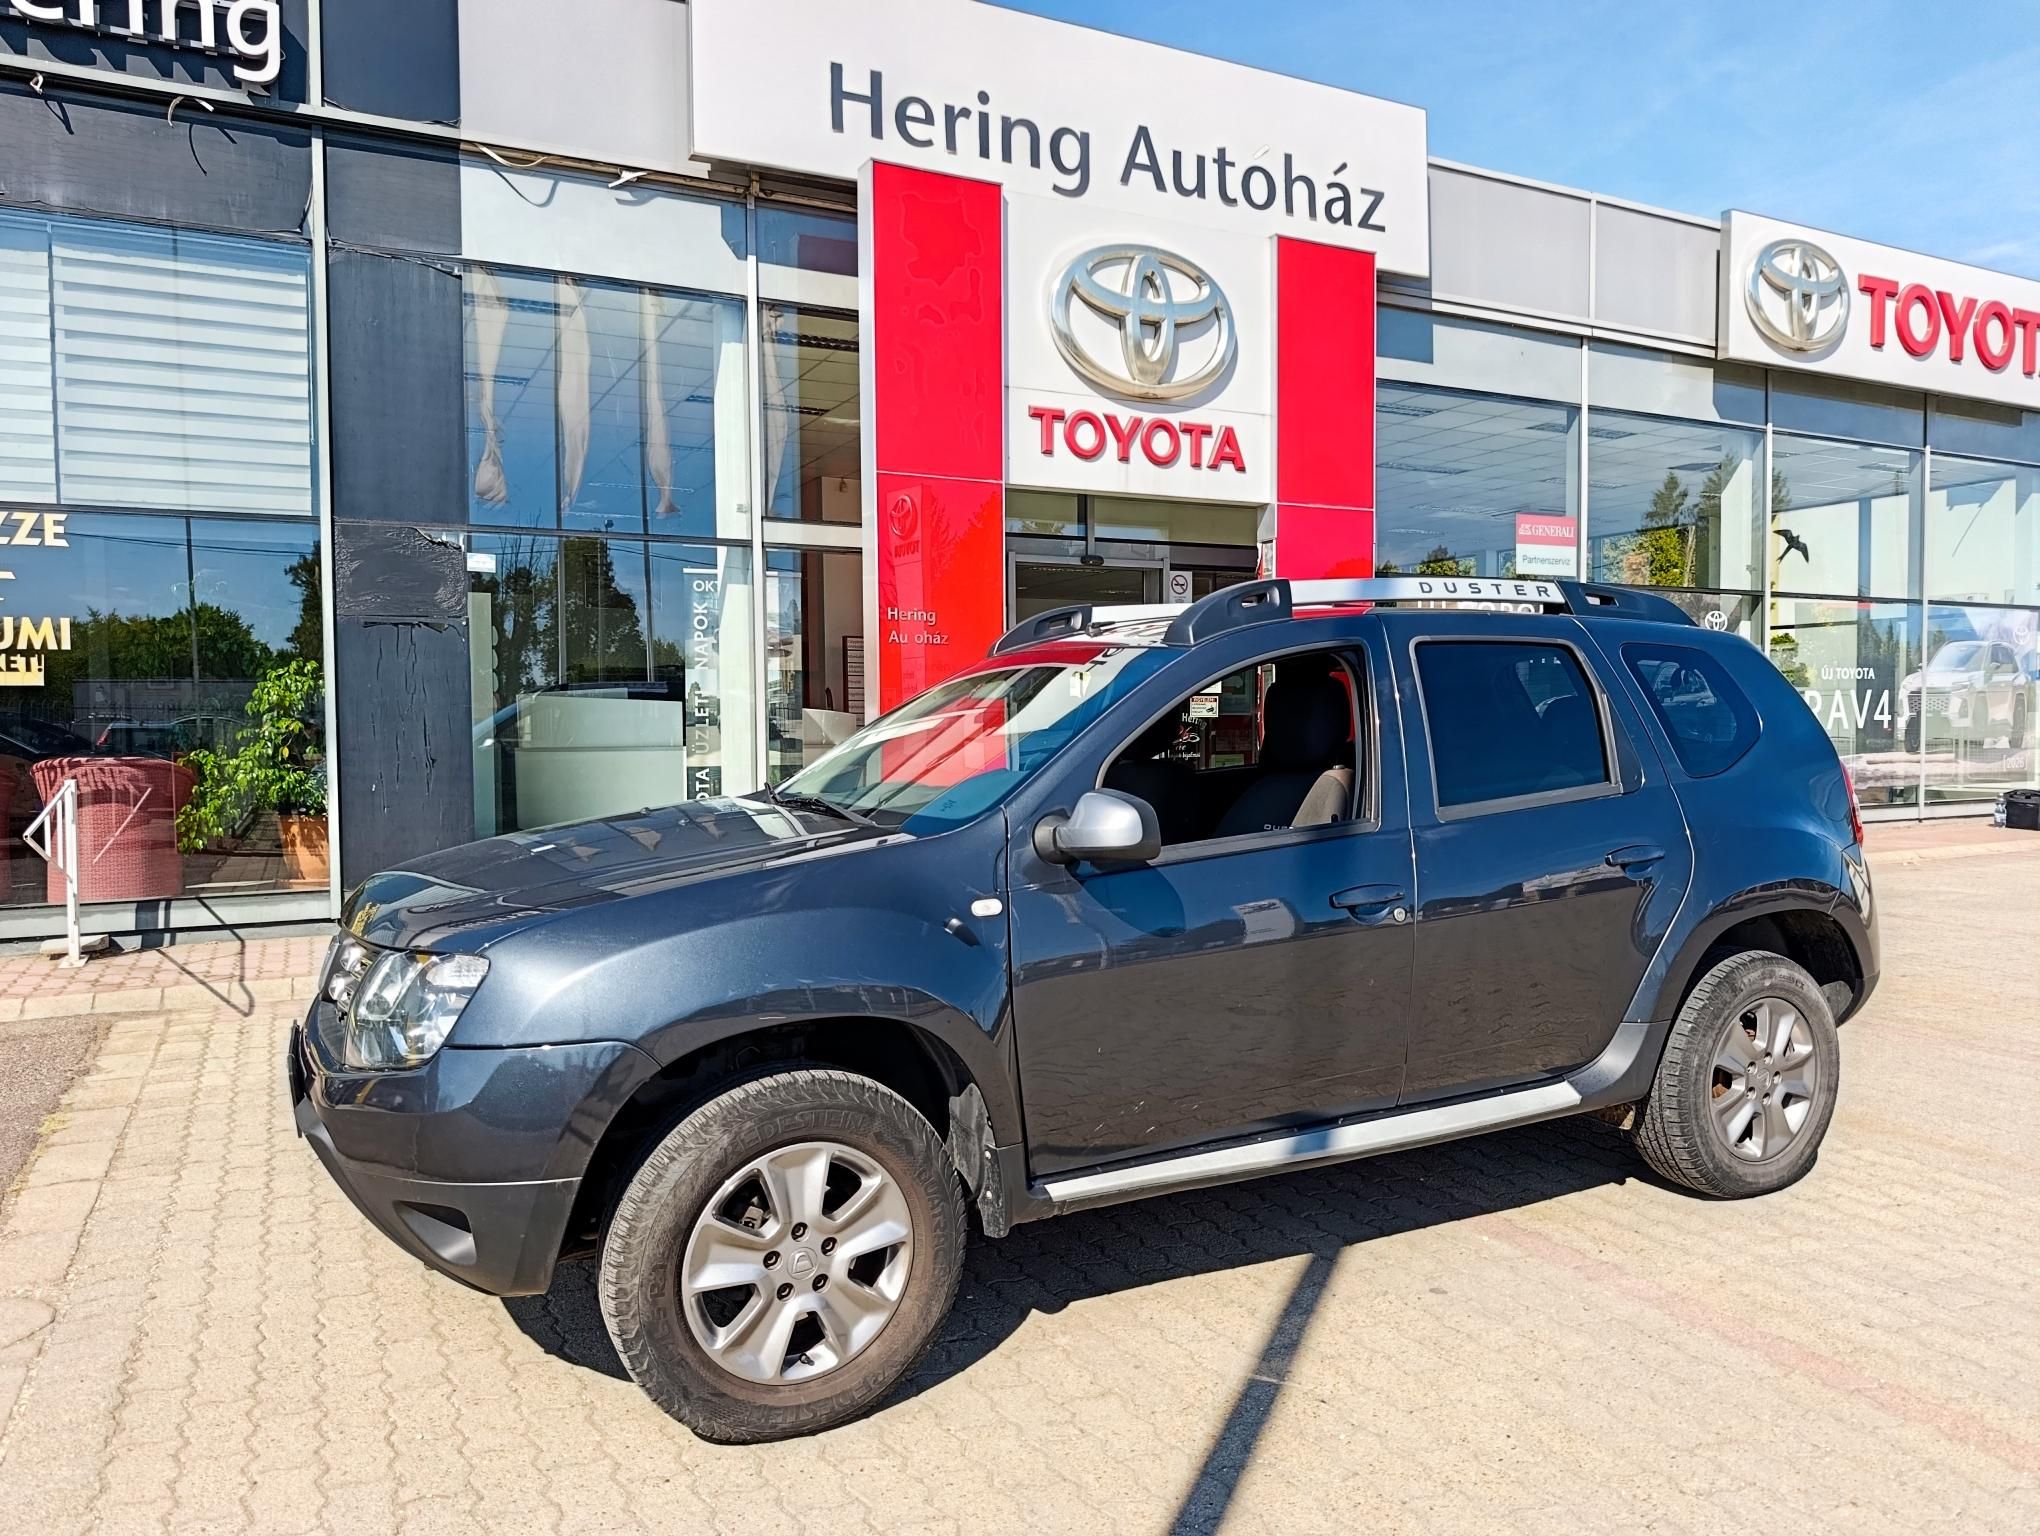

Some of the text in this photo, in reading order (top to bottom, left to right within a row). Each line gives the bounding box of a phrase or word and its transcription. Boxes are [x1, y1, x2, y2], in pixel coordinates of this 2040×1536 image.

[830, 61, 1387, 233] Hering Autóház
[1028, 404, 1247, 473] TOYOTA
[1531, 524, 1575, 538] GENERALI
[1419, 581, 1551, 598] DUSTER
[887, 606, 937, 626] Hering
[693, 602, 709, 670] NAPOK
[1821, 664, 1875, 680] ÚJ TOYOTA
